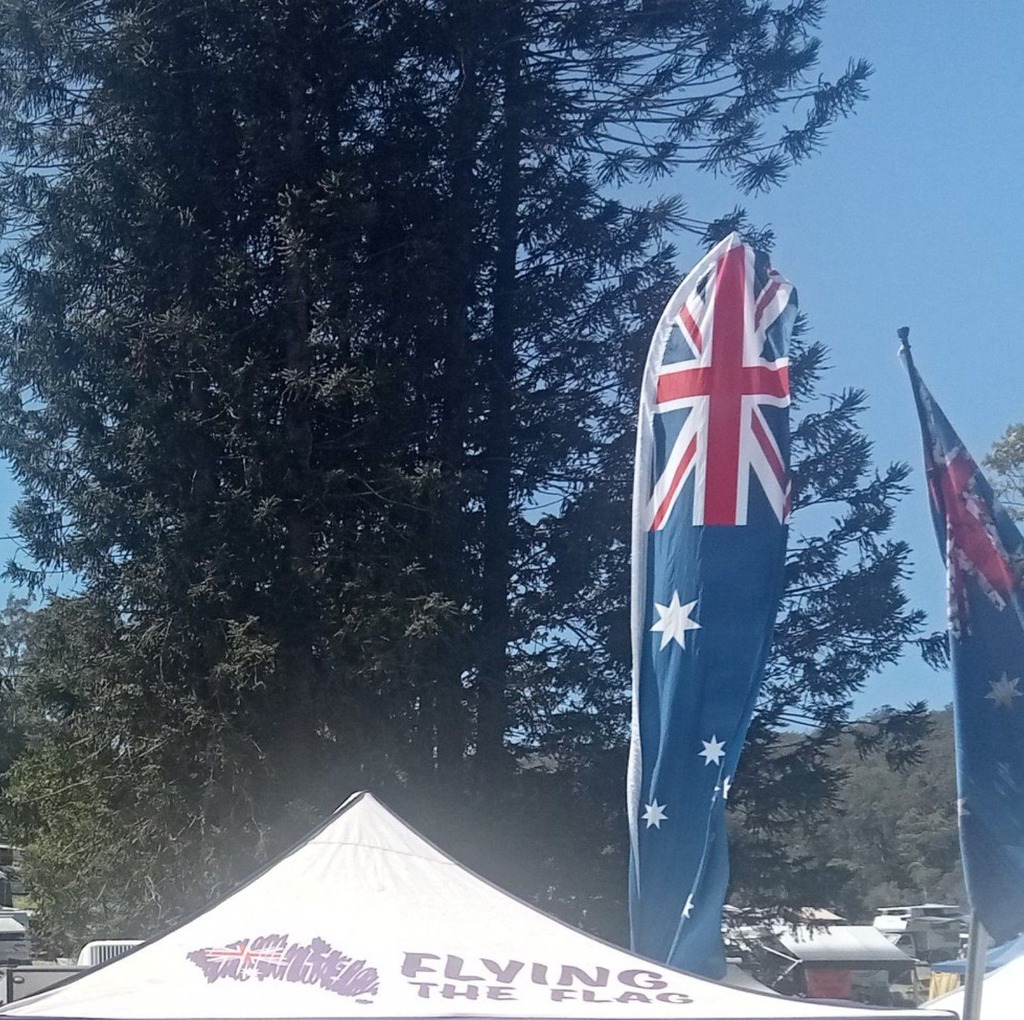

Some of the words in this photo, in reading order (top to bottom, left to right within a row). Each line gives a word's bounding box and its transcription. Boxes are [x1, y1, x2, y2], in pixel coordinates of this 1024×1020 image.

[400, 951, 669, 990] FLYING
[407, 981, 518, 1001] THE
[550, 988, 695, 1004] FLAG
